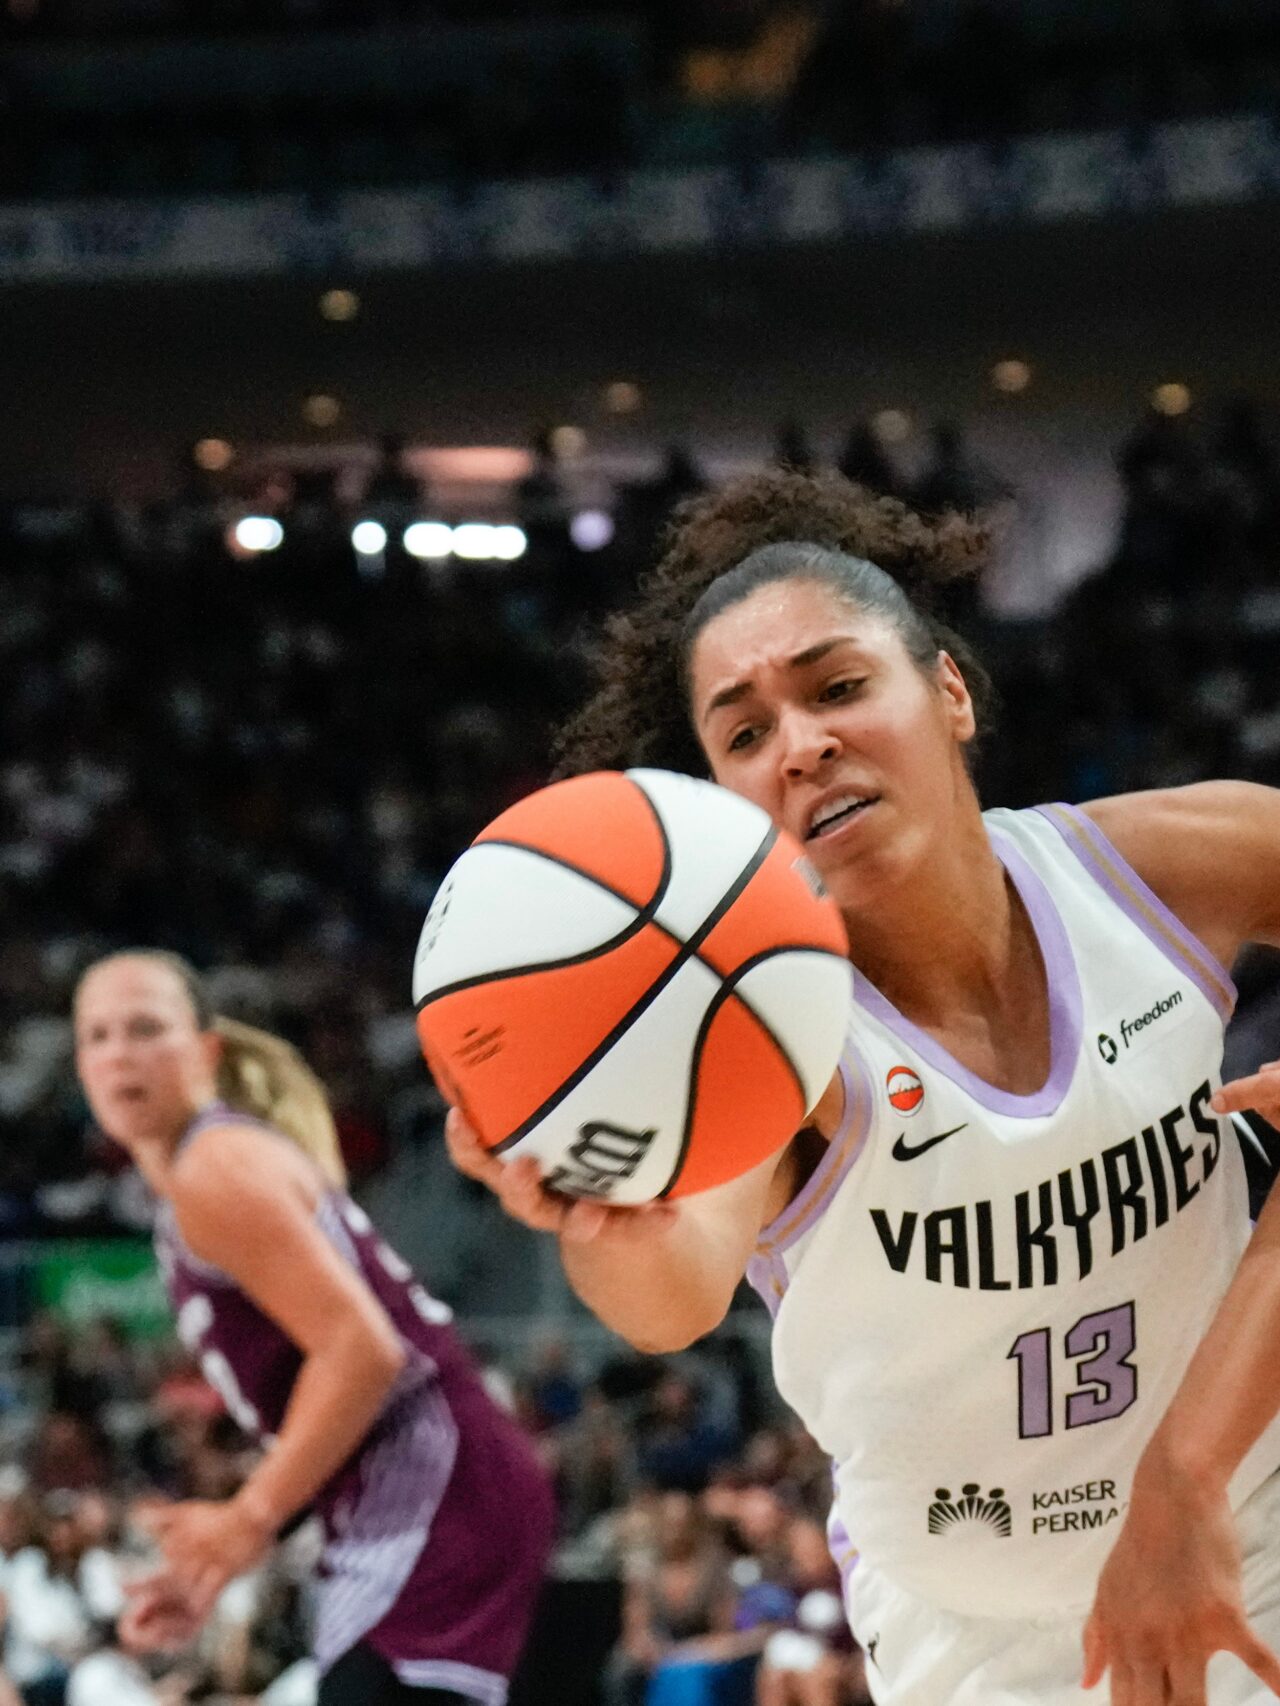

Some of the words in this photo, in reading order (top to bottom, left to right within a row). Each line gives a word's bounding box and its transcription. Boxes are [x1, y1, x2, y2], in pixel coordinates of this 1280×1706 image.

[1119, 990, 1183, 1048] freedom
[868, 1079, 1221, 1290] VALKYRIES
[1006, 1299, 1138, 1439] 13
[1032, 1479, 1117, 1510] KAISER
[1032, 1505, 1122, 1535] PERMA
